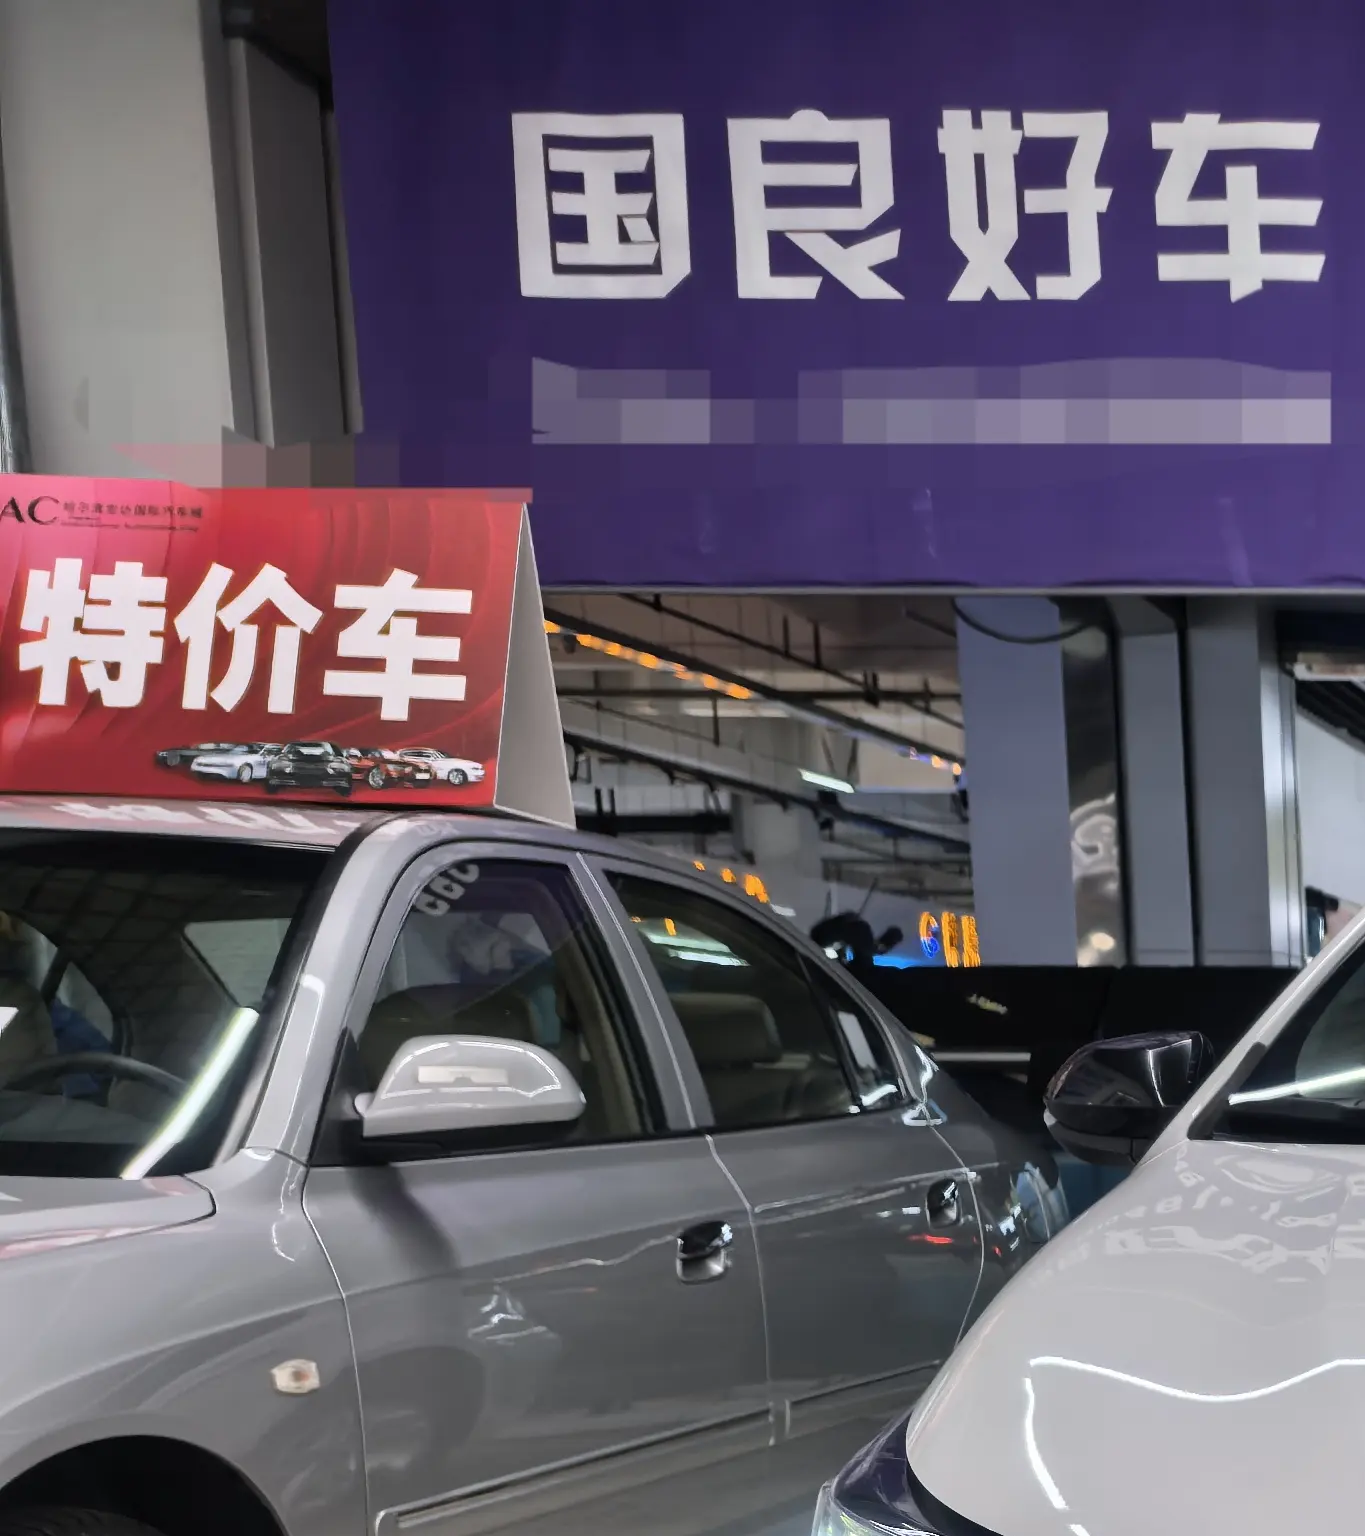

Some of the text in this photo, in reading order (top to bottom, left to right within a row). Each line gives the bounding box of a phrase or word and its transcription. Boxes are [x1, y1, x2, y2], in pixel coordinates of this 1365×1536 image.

[511, 109, 1326, 303] 国良好车
[18, 557, 473, 722] 特价车
